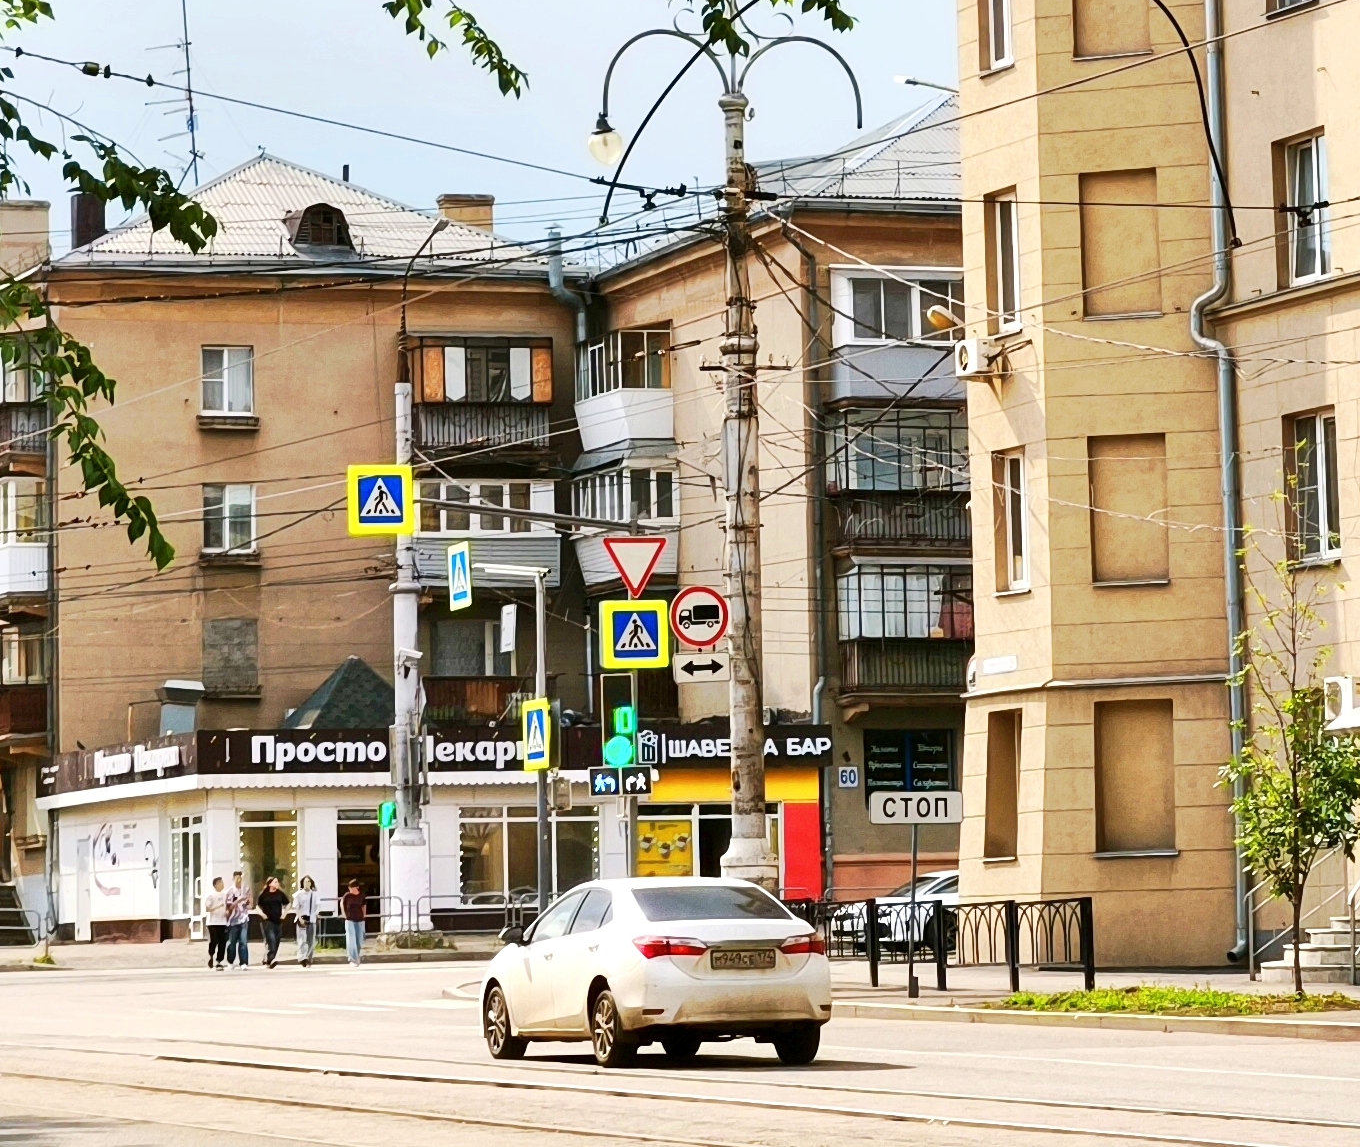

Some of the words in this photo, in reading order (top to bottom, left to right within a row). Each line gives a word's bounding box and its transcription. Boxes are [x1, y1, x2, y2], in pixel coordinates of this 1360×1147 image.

[251, 735, 387, 771] Просто
[418, 735, 525, 769] екар
[668, 738, 779, 758] ШАВЕА
[786, 737, 832, 757] БАР
[840, 769, 857, 784] 60
[882, 797, 948, 818] СТОП
